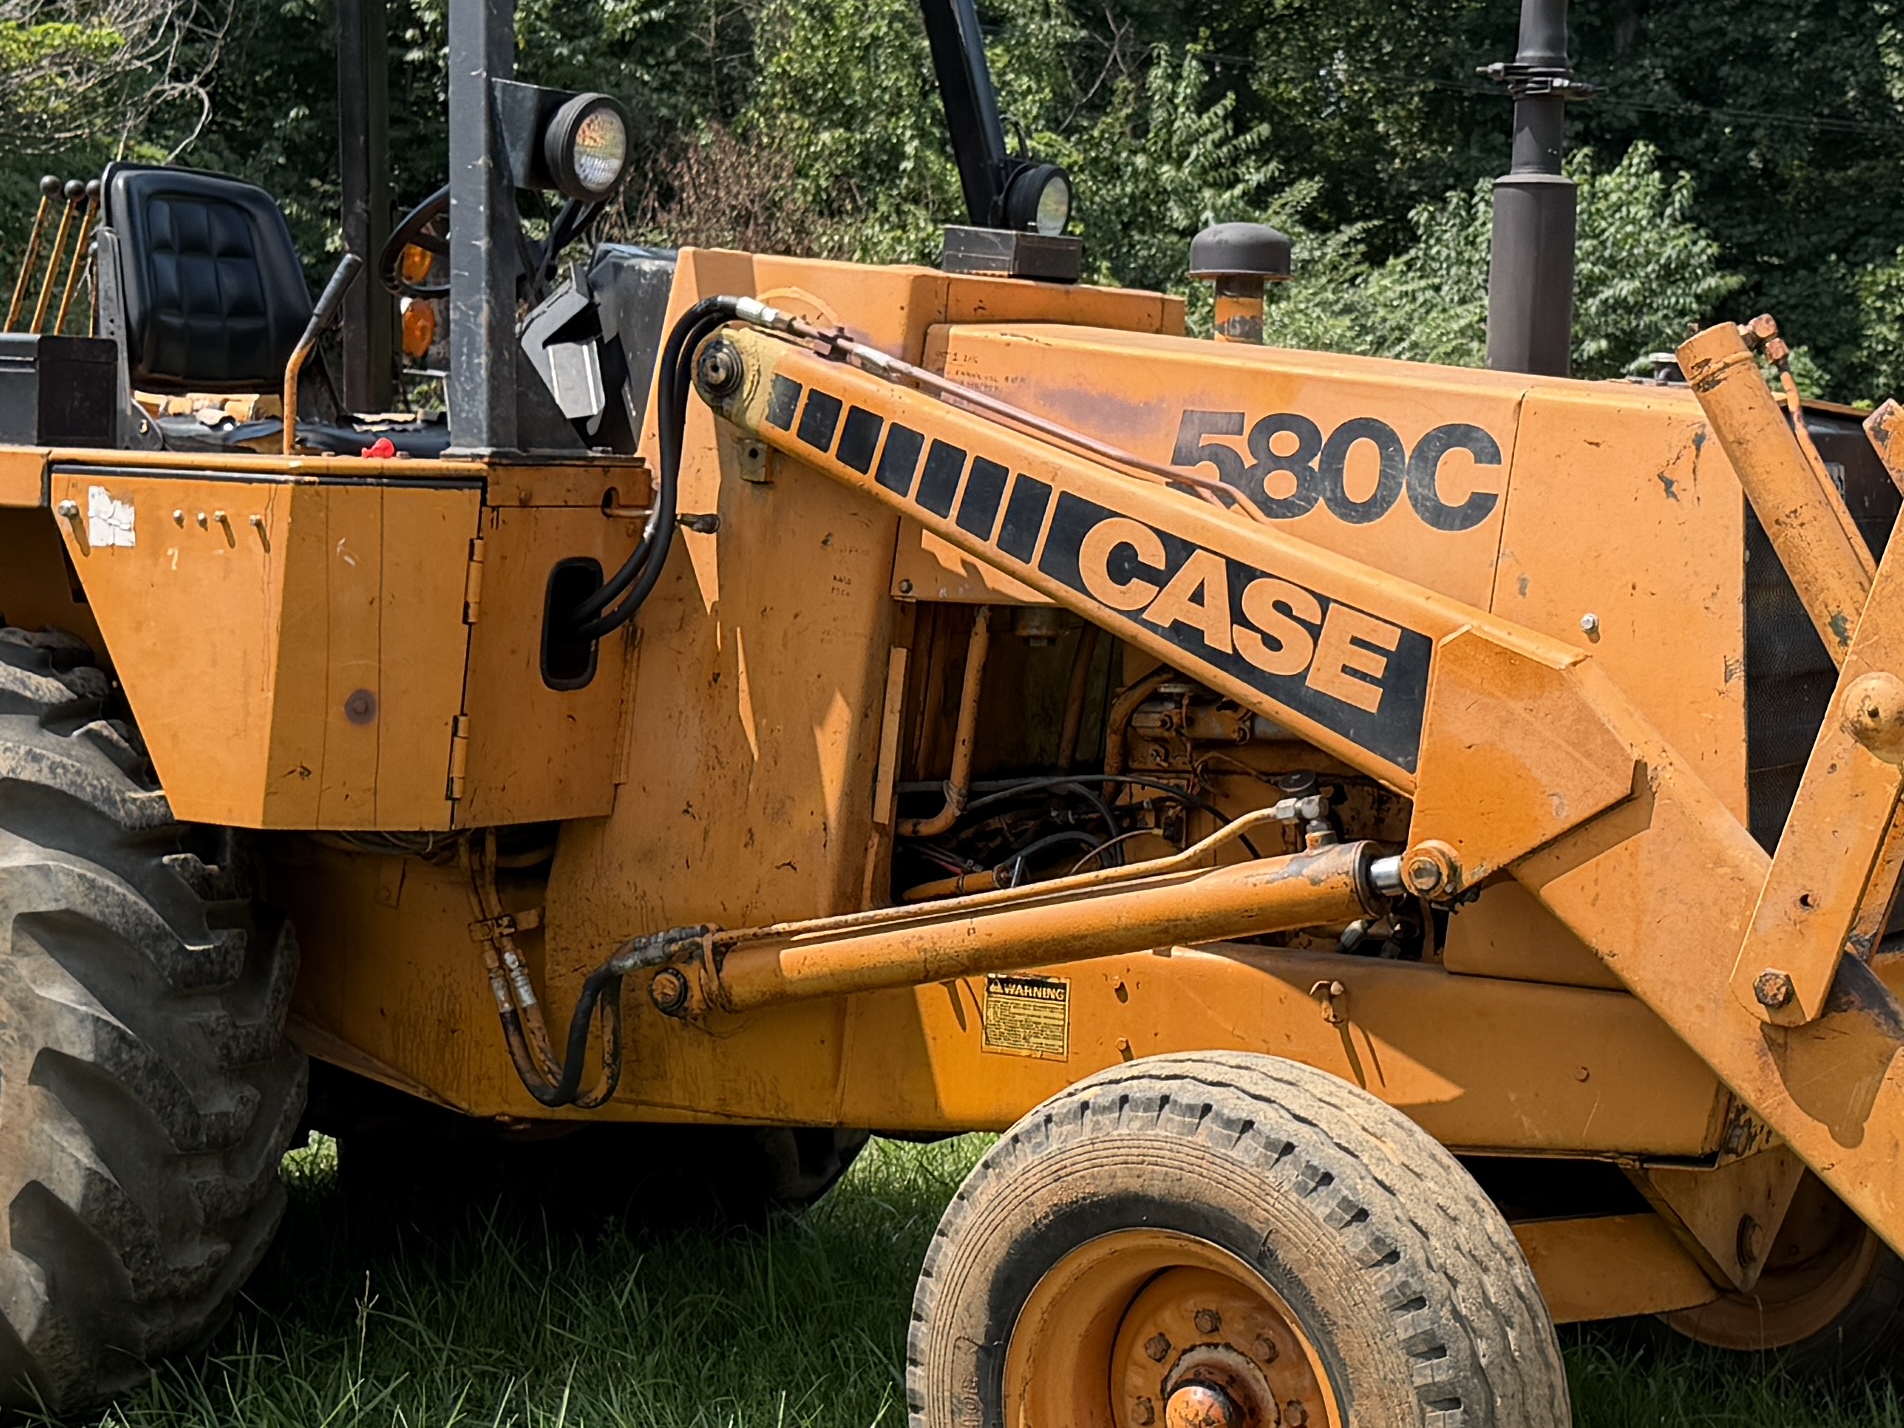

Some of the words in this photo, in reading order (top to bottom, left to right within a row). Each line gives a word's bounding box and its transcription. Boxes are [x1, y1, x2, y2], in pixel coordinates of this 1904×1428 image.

[1165, 409, 1502, 532] 580C
[1078, 517, 1402, 714] CASE
[1003, 982, 1065, 1000] WARNING
